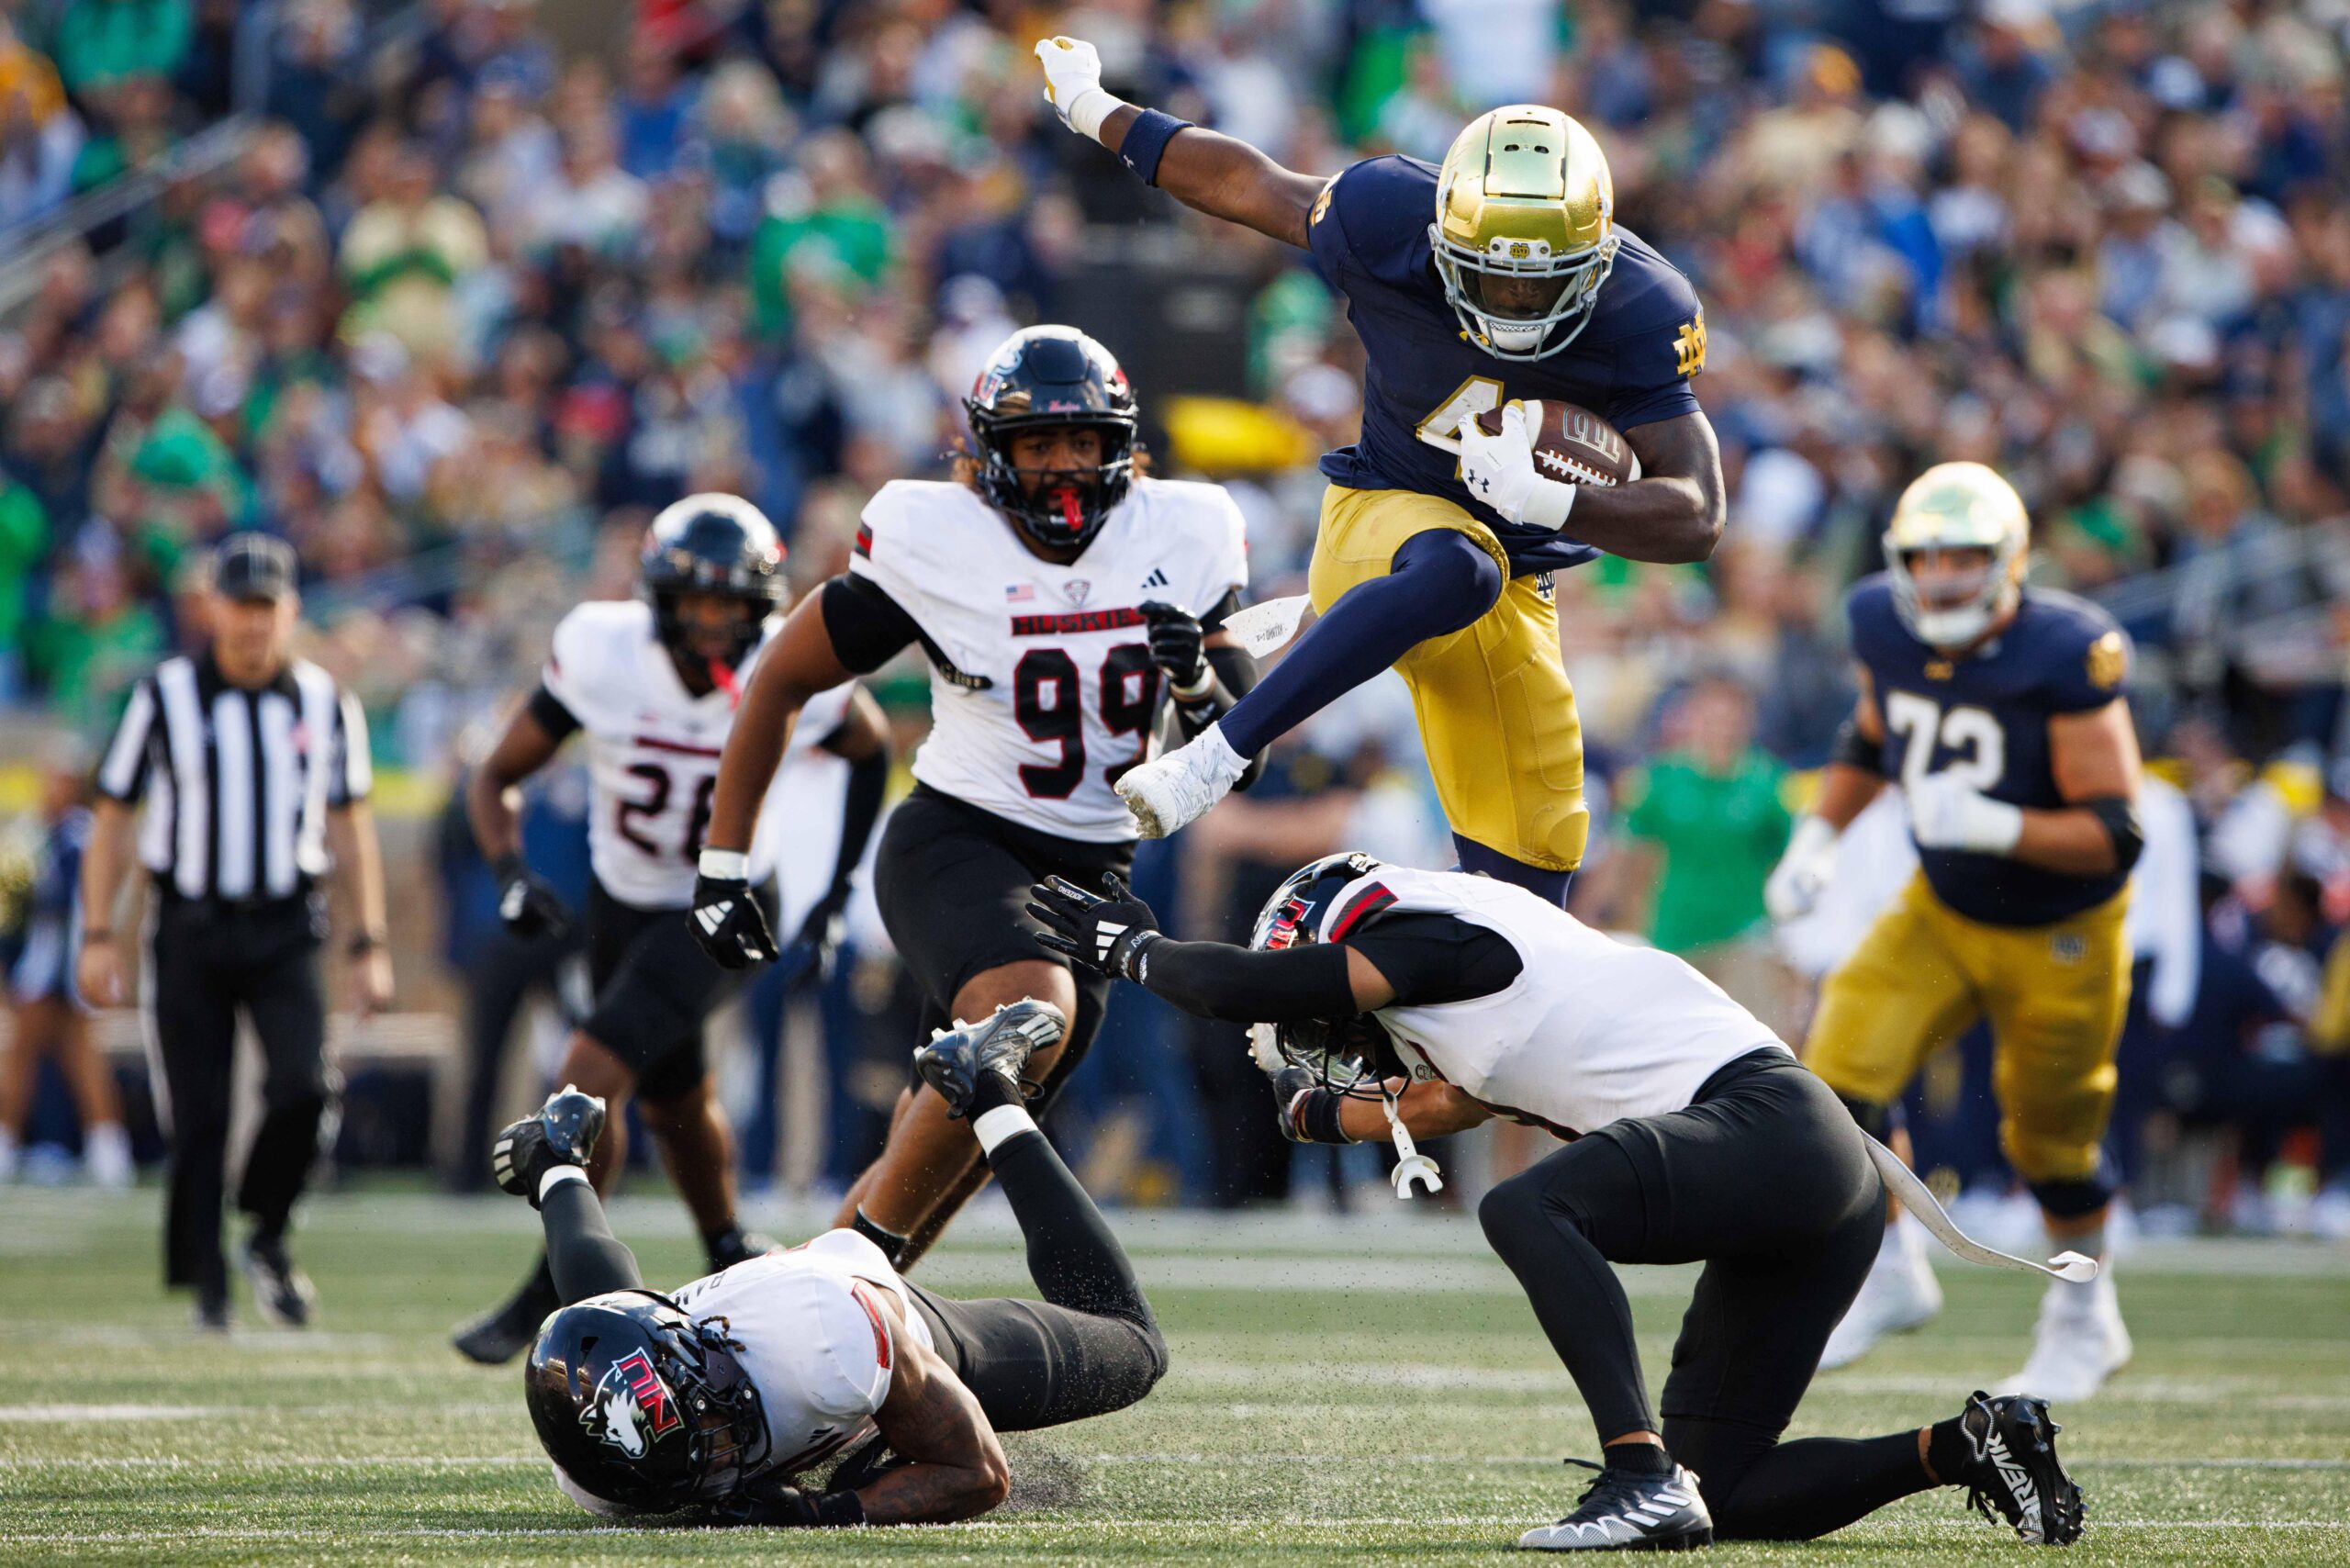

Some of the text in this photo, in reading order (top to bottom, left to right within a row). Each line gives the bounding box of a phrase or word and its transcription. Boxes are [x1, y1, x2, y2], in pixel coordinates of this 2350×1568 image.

[1415, 374, 1504, 480] 4
[1013, 643, 1160, 801] 99
[1886, 689, 2006, 793] 72
[1058, 885, 1086, 901] ADIZERO
[619, 1356, 677, 1434] NIU
